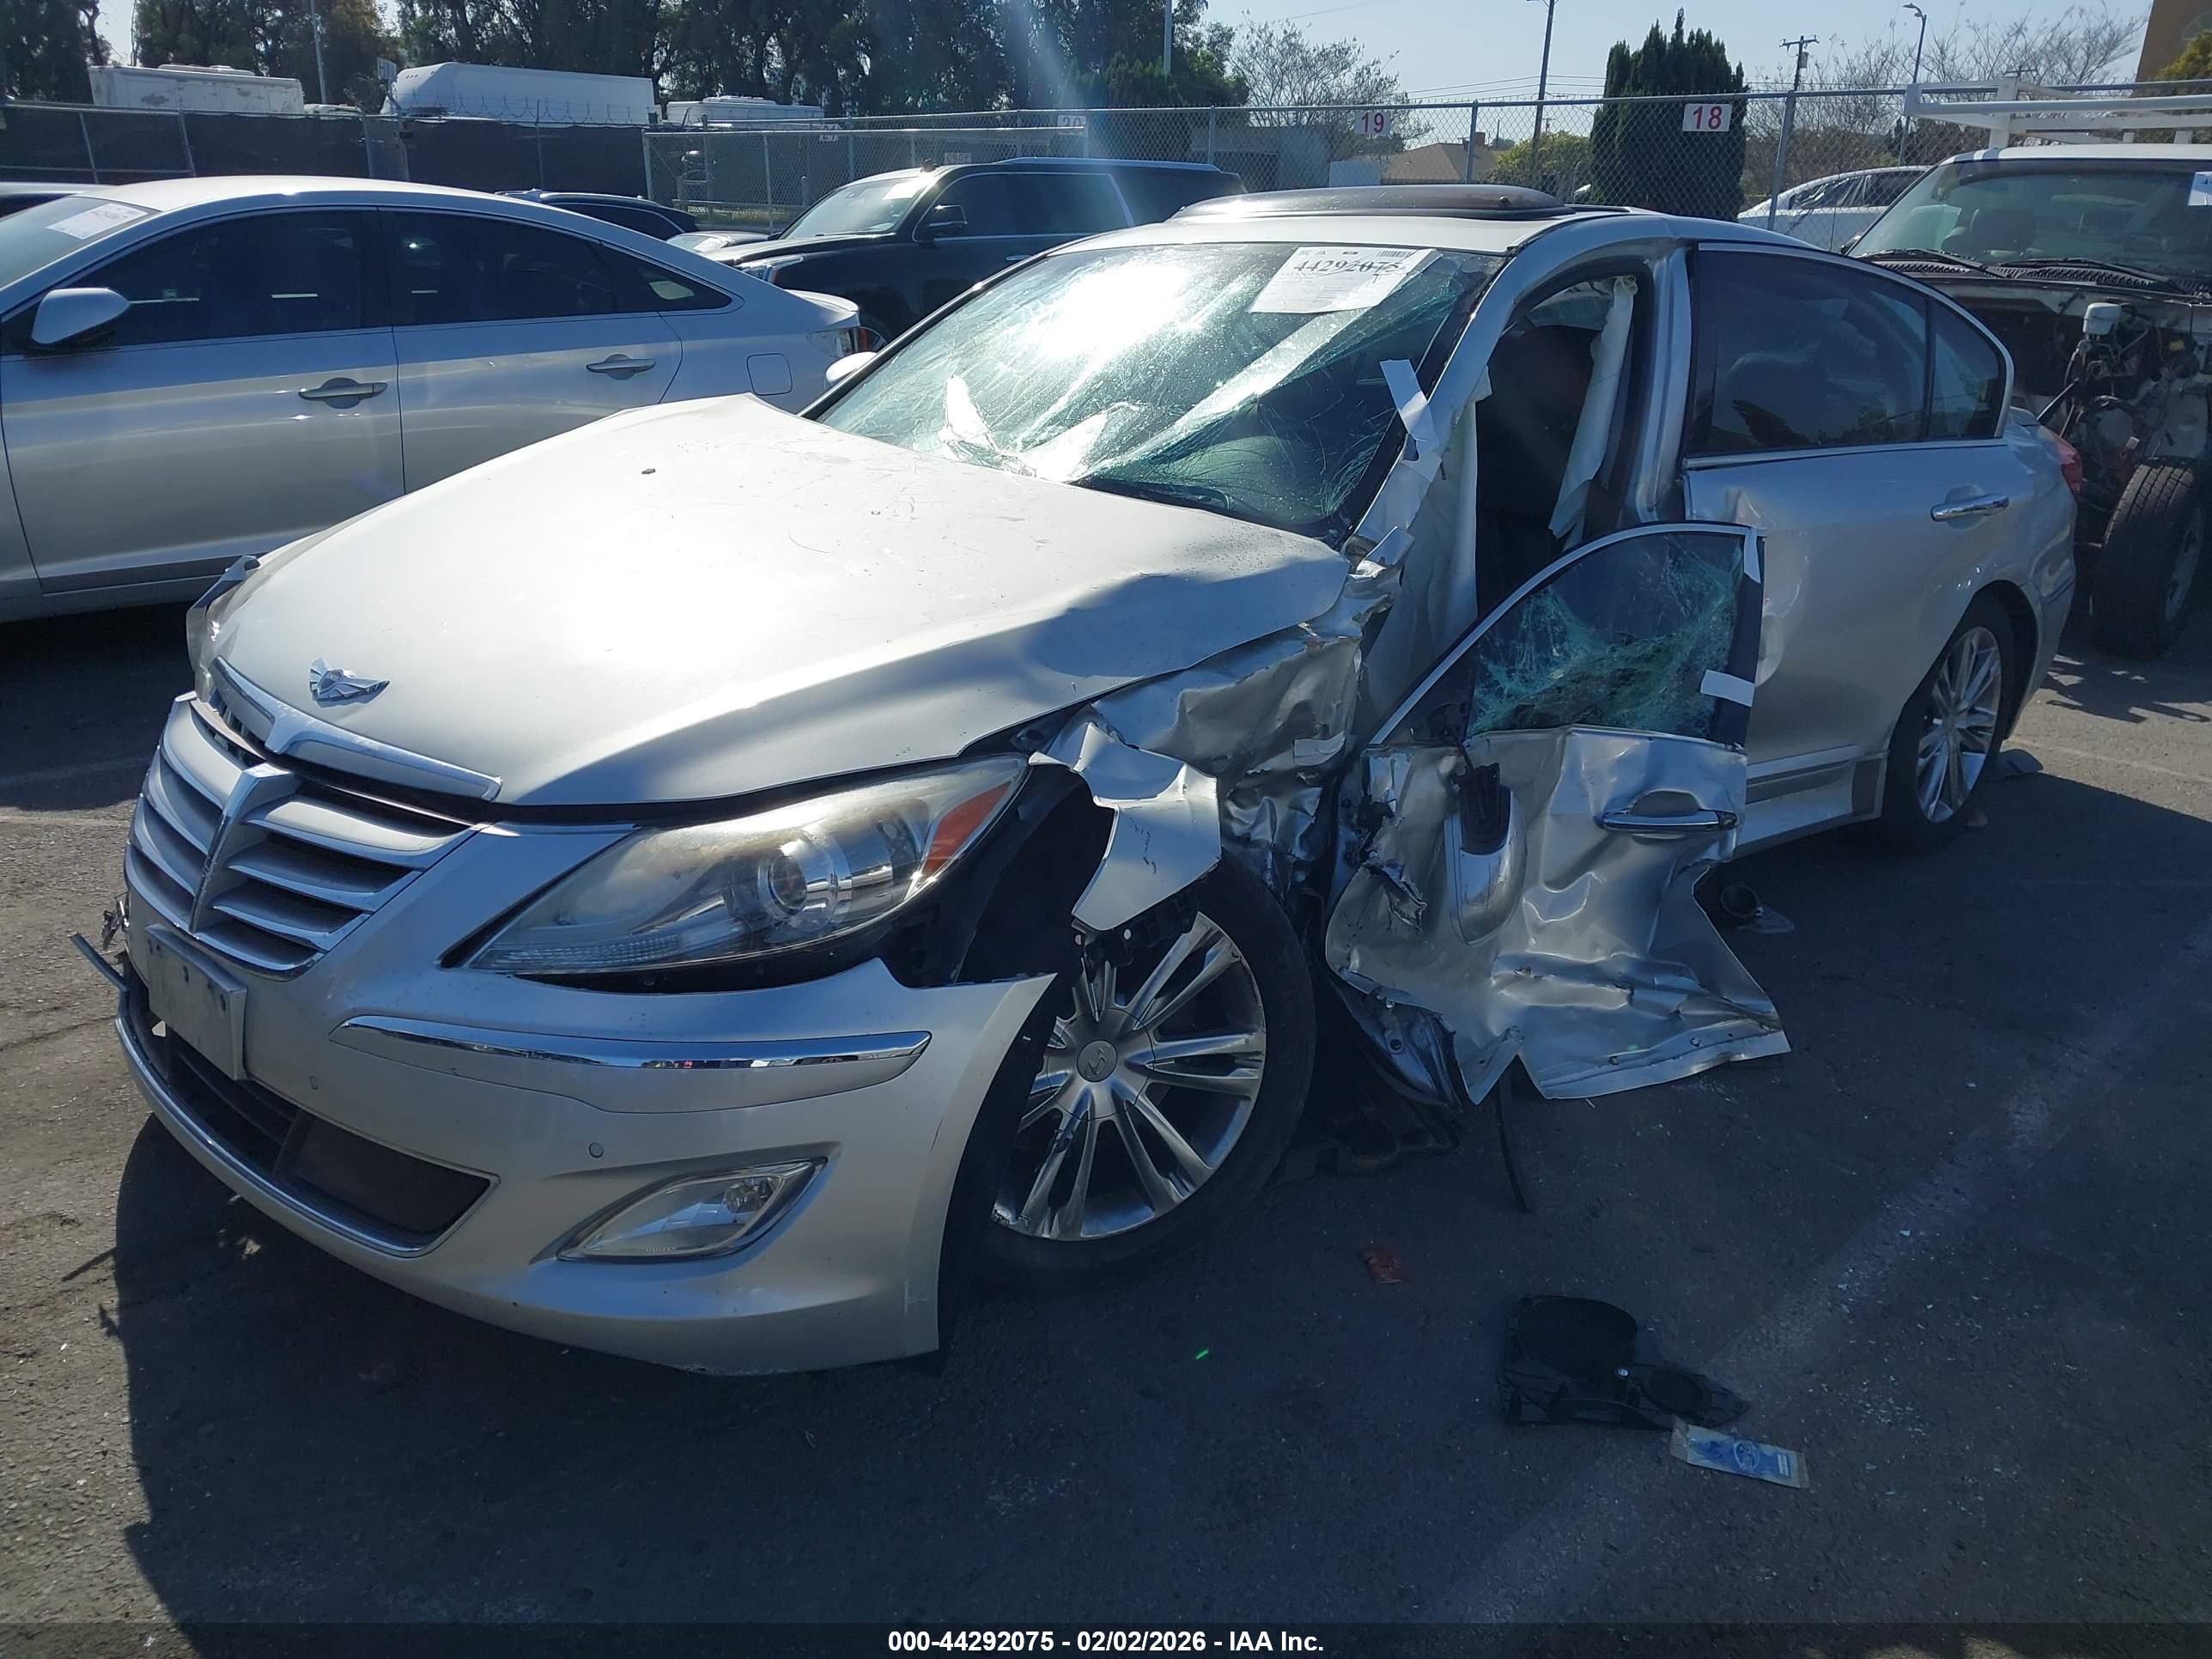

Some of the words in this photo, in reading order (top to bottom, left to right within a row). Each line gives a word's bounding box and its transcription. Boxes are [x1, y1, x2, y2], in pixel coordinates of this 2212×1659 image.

[1361, 112, 1384, 133] 19
[1692, 106, 1723, 130] 18
[1293, 259, 1400, 273] 44292075
